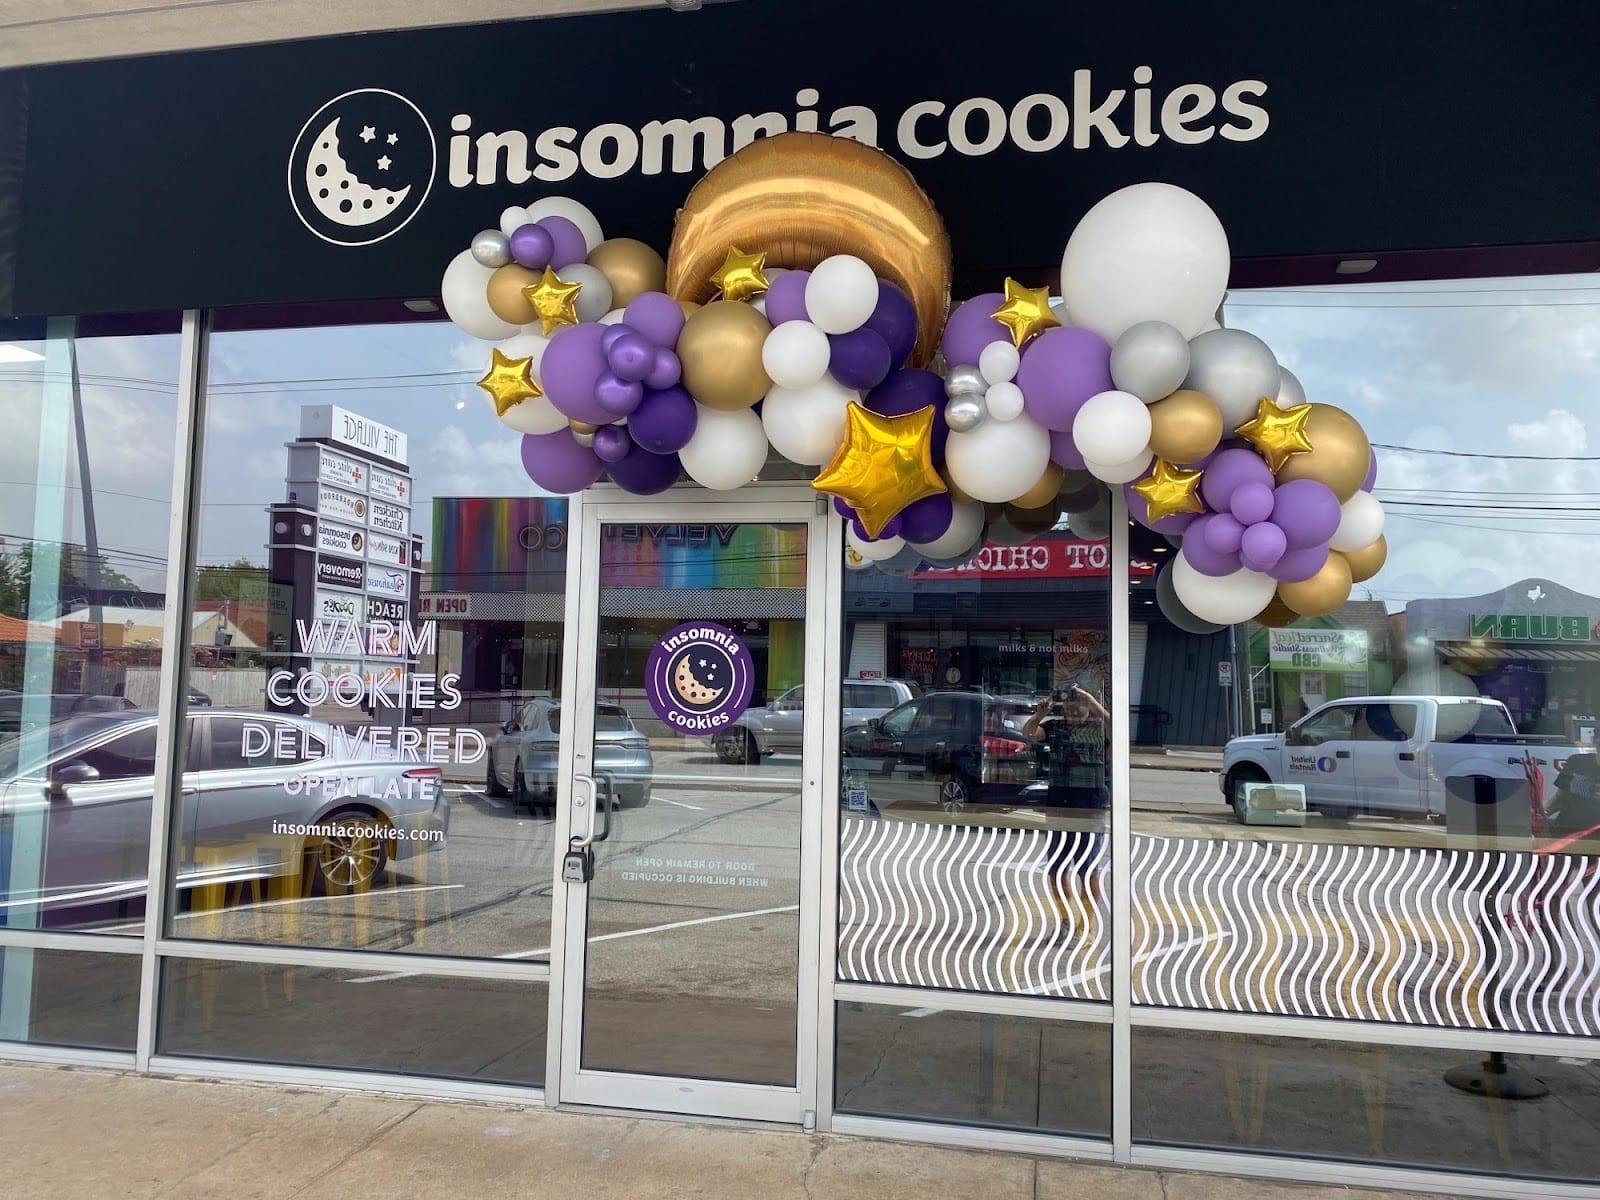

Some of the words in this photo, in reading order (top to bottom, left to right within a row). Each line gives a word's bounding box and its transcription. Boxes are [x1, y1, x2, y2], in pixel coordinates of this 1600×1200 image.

[449, 88, 884, 188] insomnia
[897, 66, 1270, 160] cookies
[296, 619, 436, 656] WARM
[661, 628, 740, 656] insomnia
[998, 643, 1027, 653] milks
[1038, 644, 1057, 653] not
[1060, 643, 1089, 654] milks
[267, 671, 462, 710] COOKIES
[668, 710, 729, 729] cookies
[241, 723, 486, 764] DELIVERED
[284, 772, 357, 798] OPEN
[370, 776, 435, 800] LATE
[272, 820, 444, 842] insomniacookies.com
